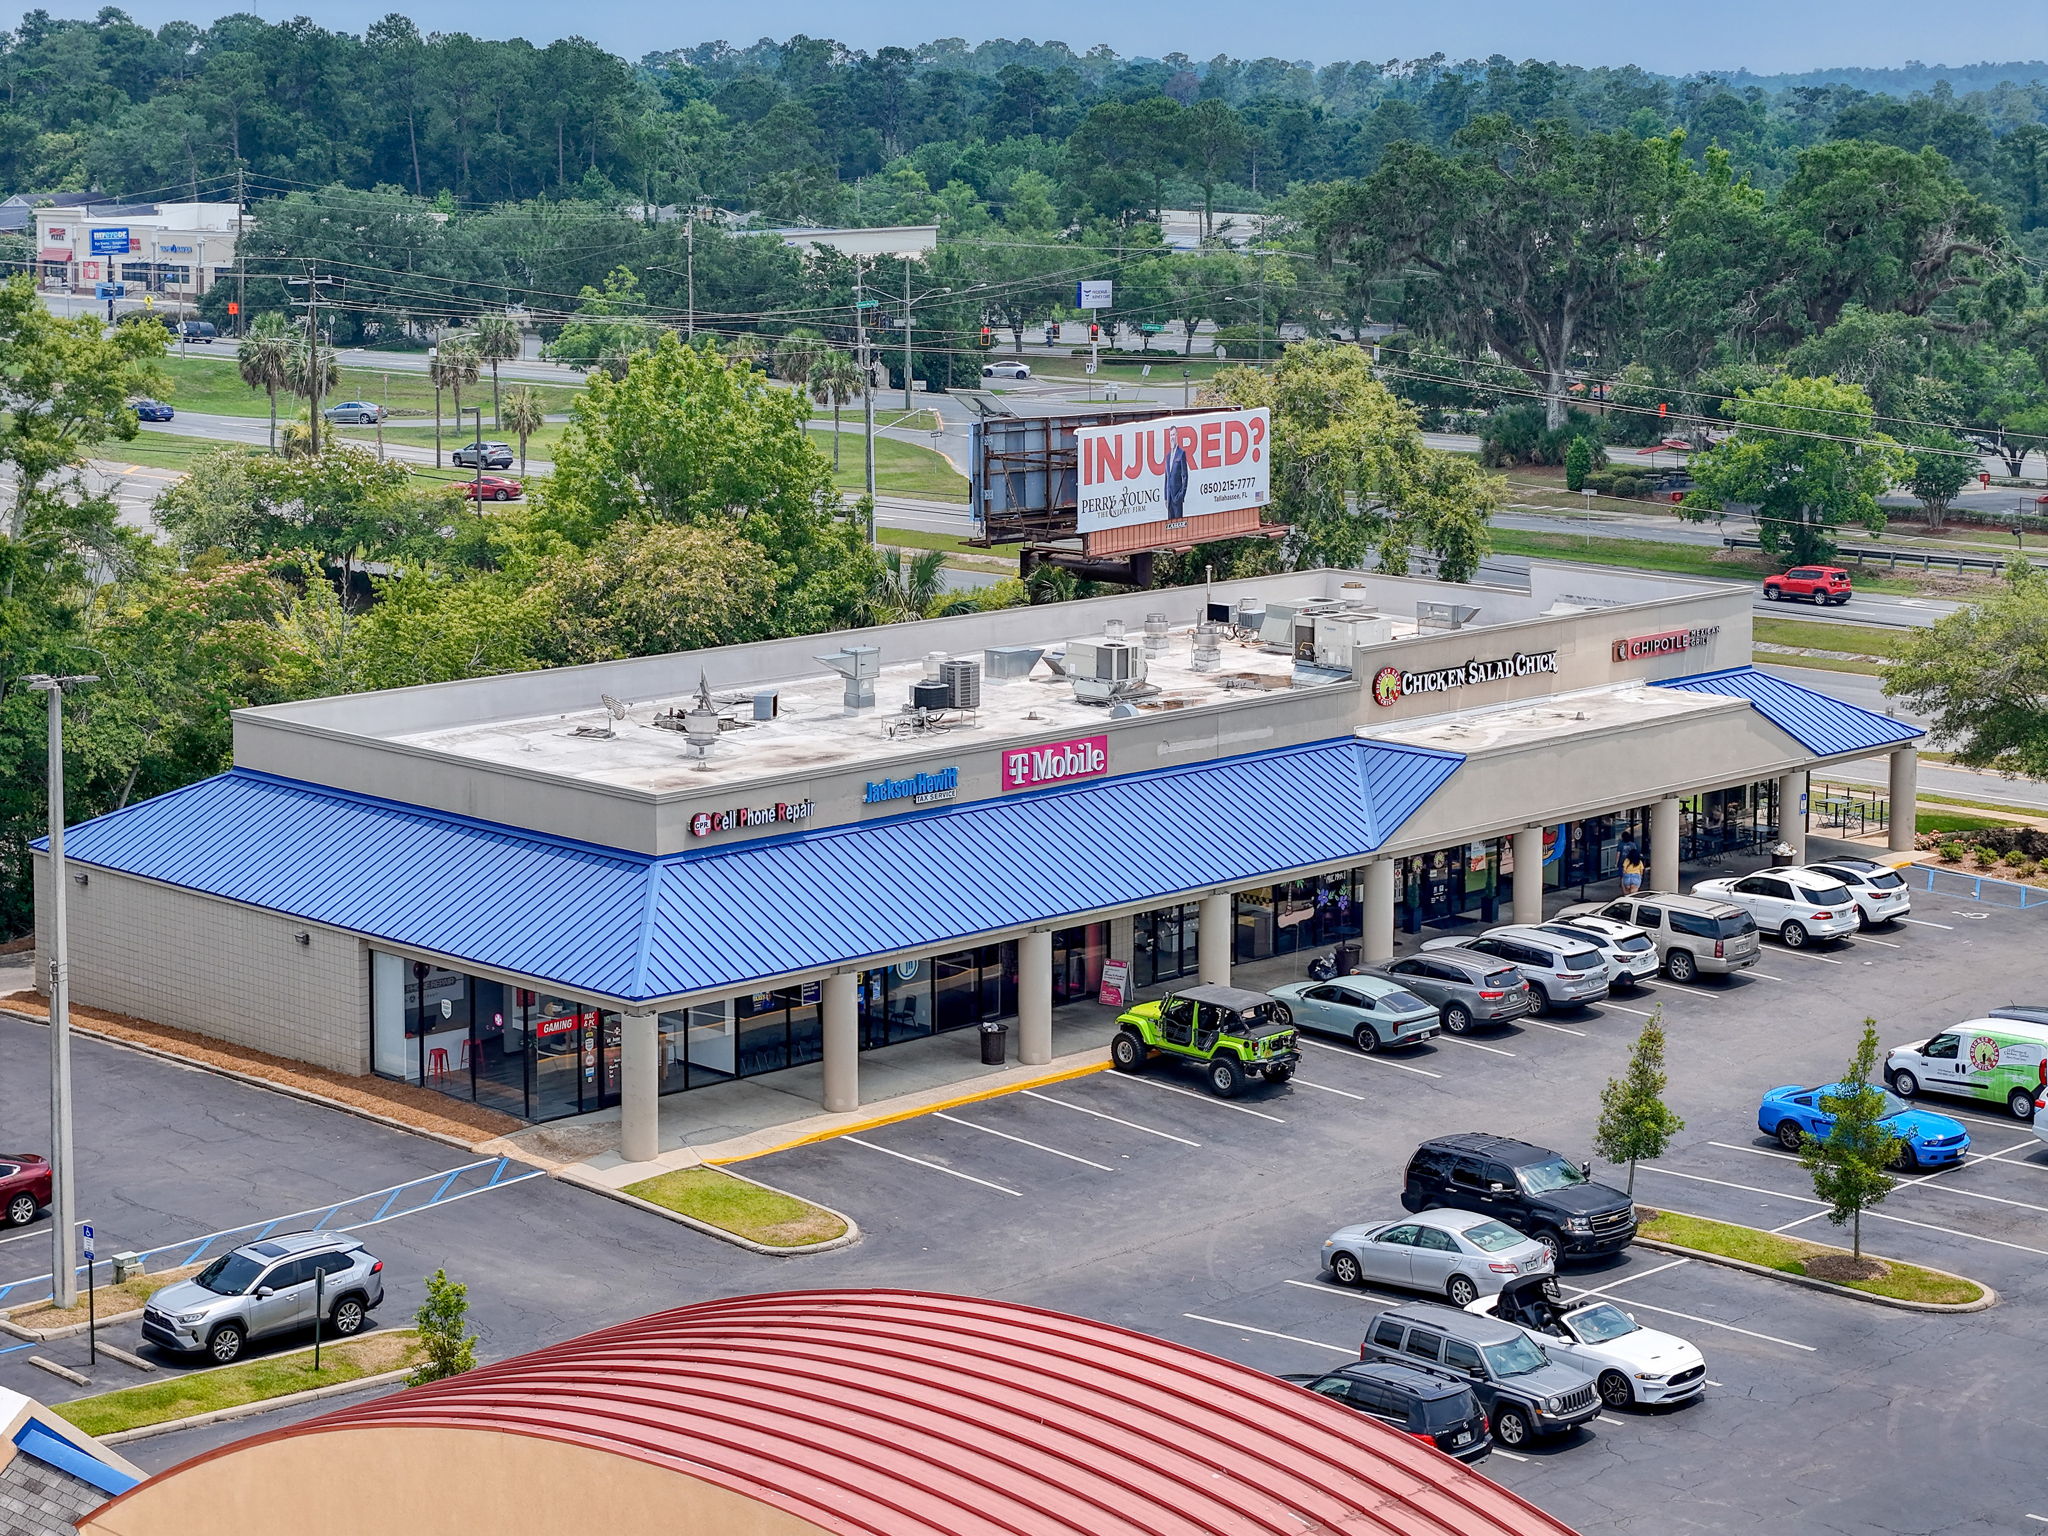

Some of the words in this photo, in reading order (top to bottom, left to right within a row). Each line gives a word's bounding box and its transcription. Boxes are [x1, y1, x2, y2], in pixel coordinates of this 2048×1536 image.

[1084, 417, 1265, 486] INJURED?
[1200, 477, 1256, 496] (850)215-7777
[1082, 495, 1116, 513] PERRY
[1122, 489, 1160, 506] YOUNG
[1214, 494, 1241, 503] Tallahassee,
[1097, 510, 1108, 518] THE
[1132, 505, 1146, 513] FIRM
[1691, 626, 1720, 637] MEXICAN
[1633, 634, 1689, 655] CHIPOTLE
[1402, 667, 1466, 695] CHICKEN
[1468, 659, 1514, 684] SALAD
[1515, 652, 1558, 676] CHICK
[1031, 743, 1104, 782] Mobile
[863, 777, 916, 804] Jackson
[916, 767, 959, 794] Hewitt
[917, 793, 929, 804] TAX
[930, 789, 957, 802] SERVICE
[713, 810, 736, 832] Cell
[740, 807, 776, 827] Phone
[778, 799, 816, 823] Repair
[695, 821, 709, 830] CPR
[584, 1012, 595, 1020] MAC
[543, 1019, 572, 1033] GAMING
[1970, 1037, 1988, 1056] CHICKEN
[1989, 1040, 1999, 1061] SALAD
[1974, 1061, 1992, 1071] CHICK
